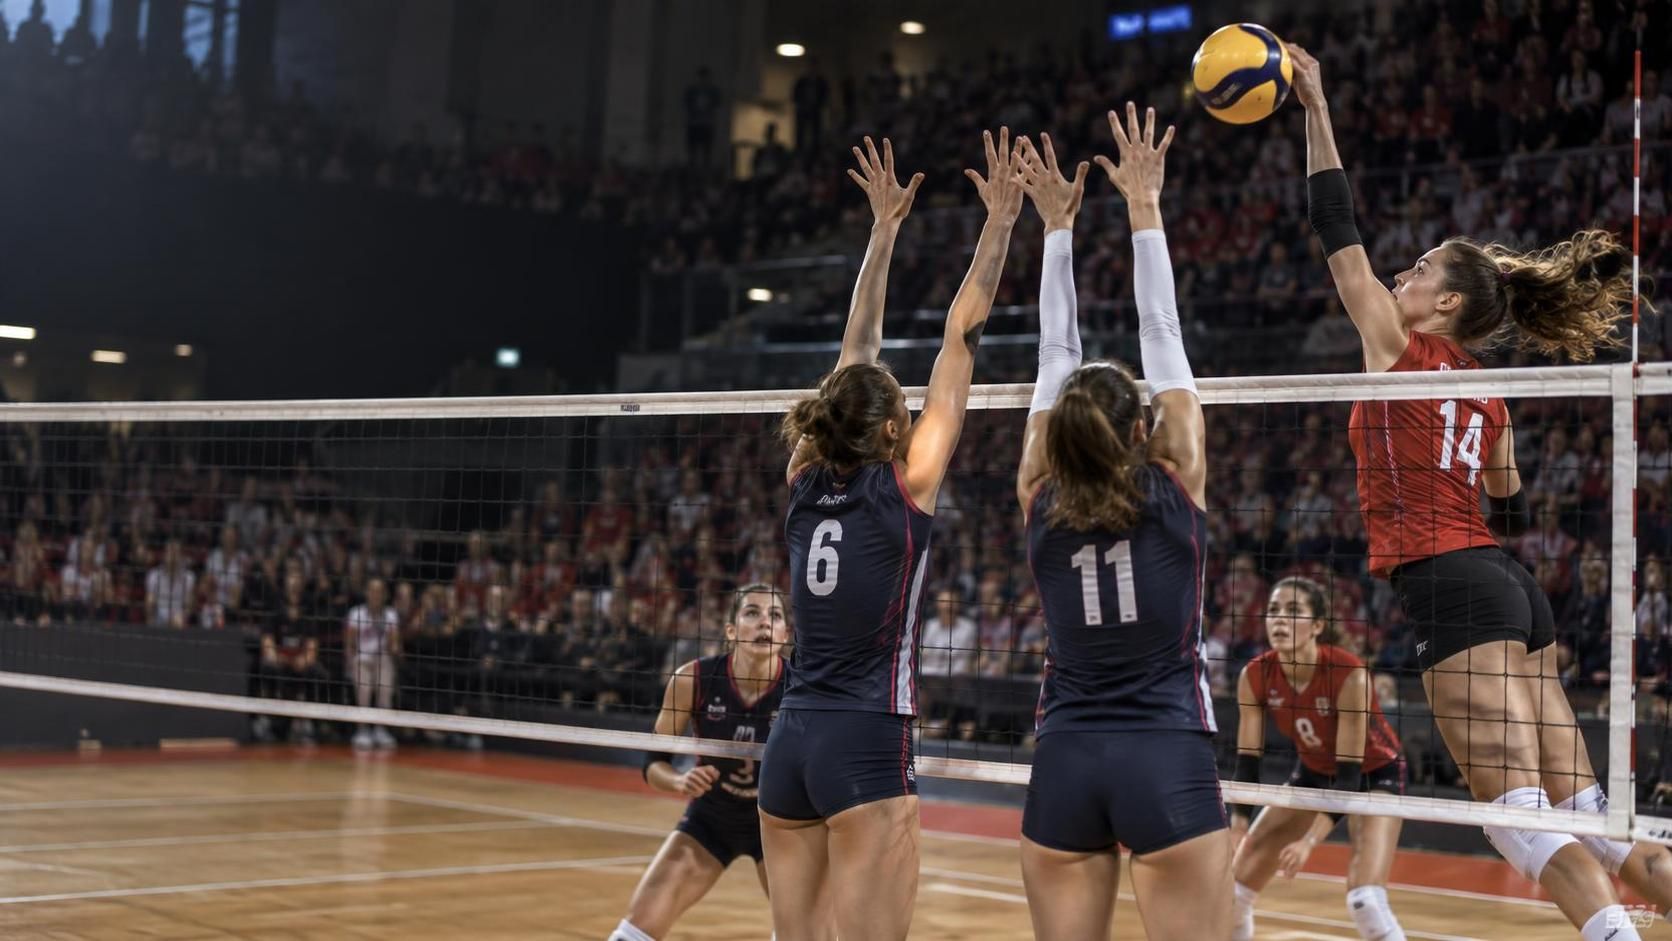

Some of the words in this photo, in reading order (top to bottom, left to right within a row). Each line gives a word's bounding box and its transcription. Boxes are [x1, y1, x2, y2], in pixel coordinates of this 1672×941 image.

[1439, 400, 1484, 487] 14
[806, 519, 843, 596] 6
[1071, 539, 1138, 626] 11
[1295, 718, 1323, 747] 8
